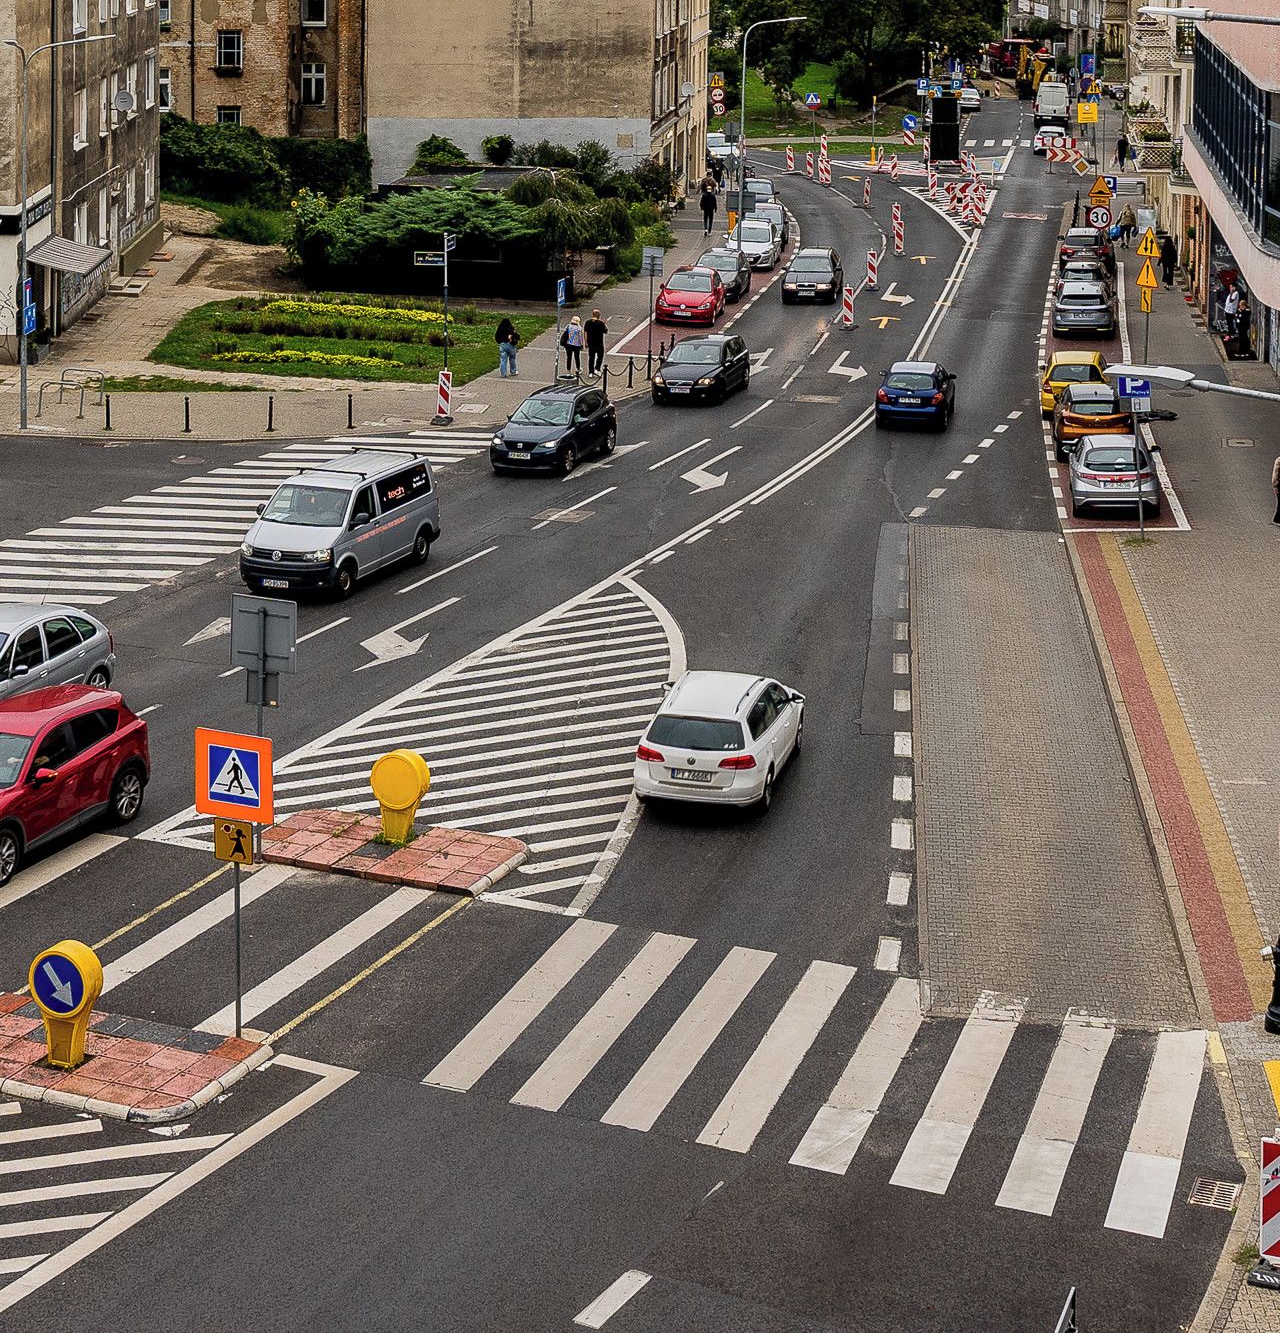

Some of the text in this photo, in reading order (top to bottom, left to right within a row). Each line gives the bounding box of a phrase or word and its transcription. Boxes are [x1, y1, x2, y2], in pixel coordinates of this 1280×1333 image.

[1091, 211, 1109, 223] 30
[1125, 377, 1144, 393] P
[387, 486, 405, 499] tech
